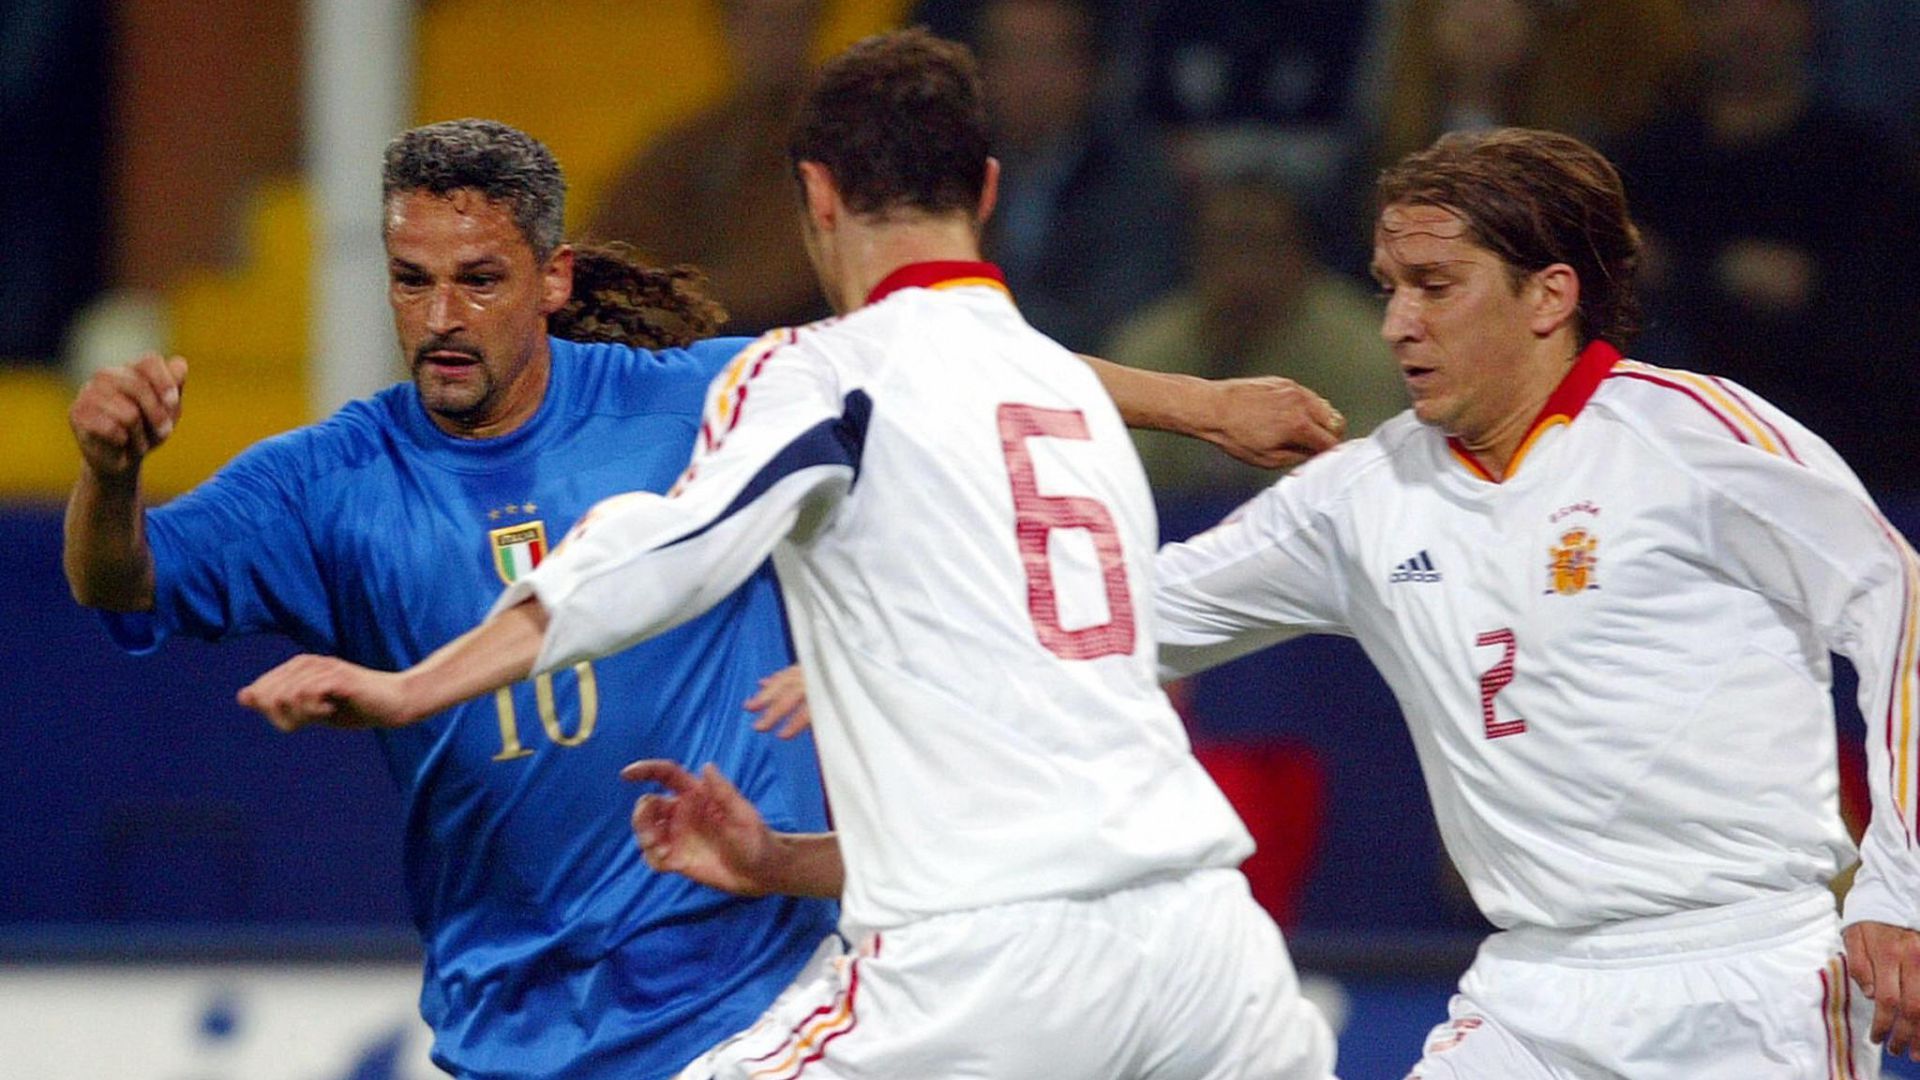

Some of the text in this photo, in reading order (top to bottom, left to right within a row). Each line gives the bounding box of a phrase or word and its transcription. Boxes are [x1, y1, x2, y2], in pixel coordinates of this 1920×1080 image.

[996, 402, 1136, 661] 6
[492, 661, 597, 761] 10
[1476, 627, 1528, 740] 2
